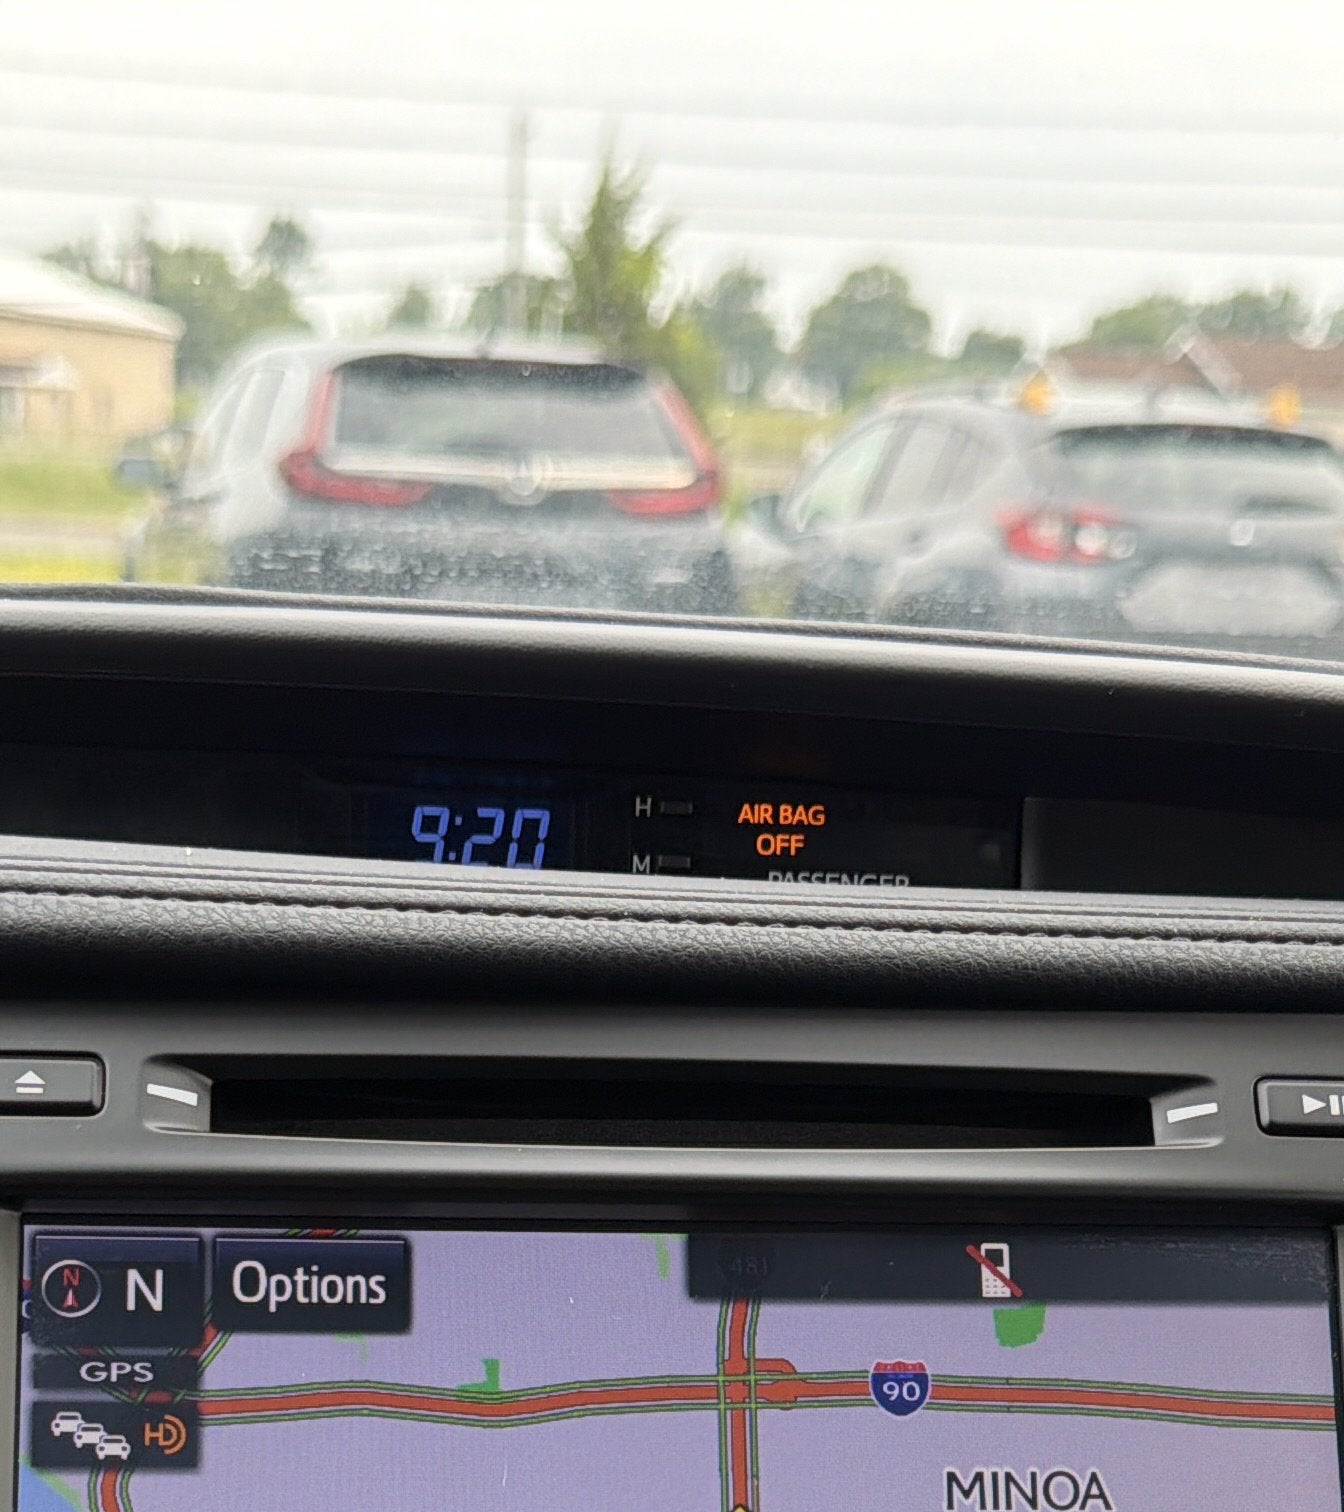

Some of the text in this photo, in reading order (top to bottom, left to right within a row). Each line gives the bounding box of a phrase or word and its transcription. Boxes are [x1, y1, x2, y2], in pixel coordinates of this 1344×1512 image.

[737, 803, 825, 826] AIR BAG
[411, 805, 550, 869] 9:20
[756, 833, 805, 856] OFF
[126, 1268, 164, 1312] N
[232, 1260, 386, 1309] Options
[79, 1361, 154, 1383] GPS
[882, 1381, 920, 1401] 90
[946, 1470, 1113, 1511] MINOA
